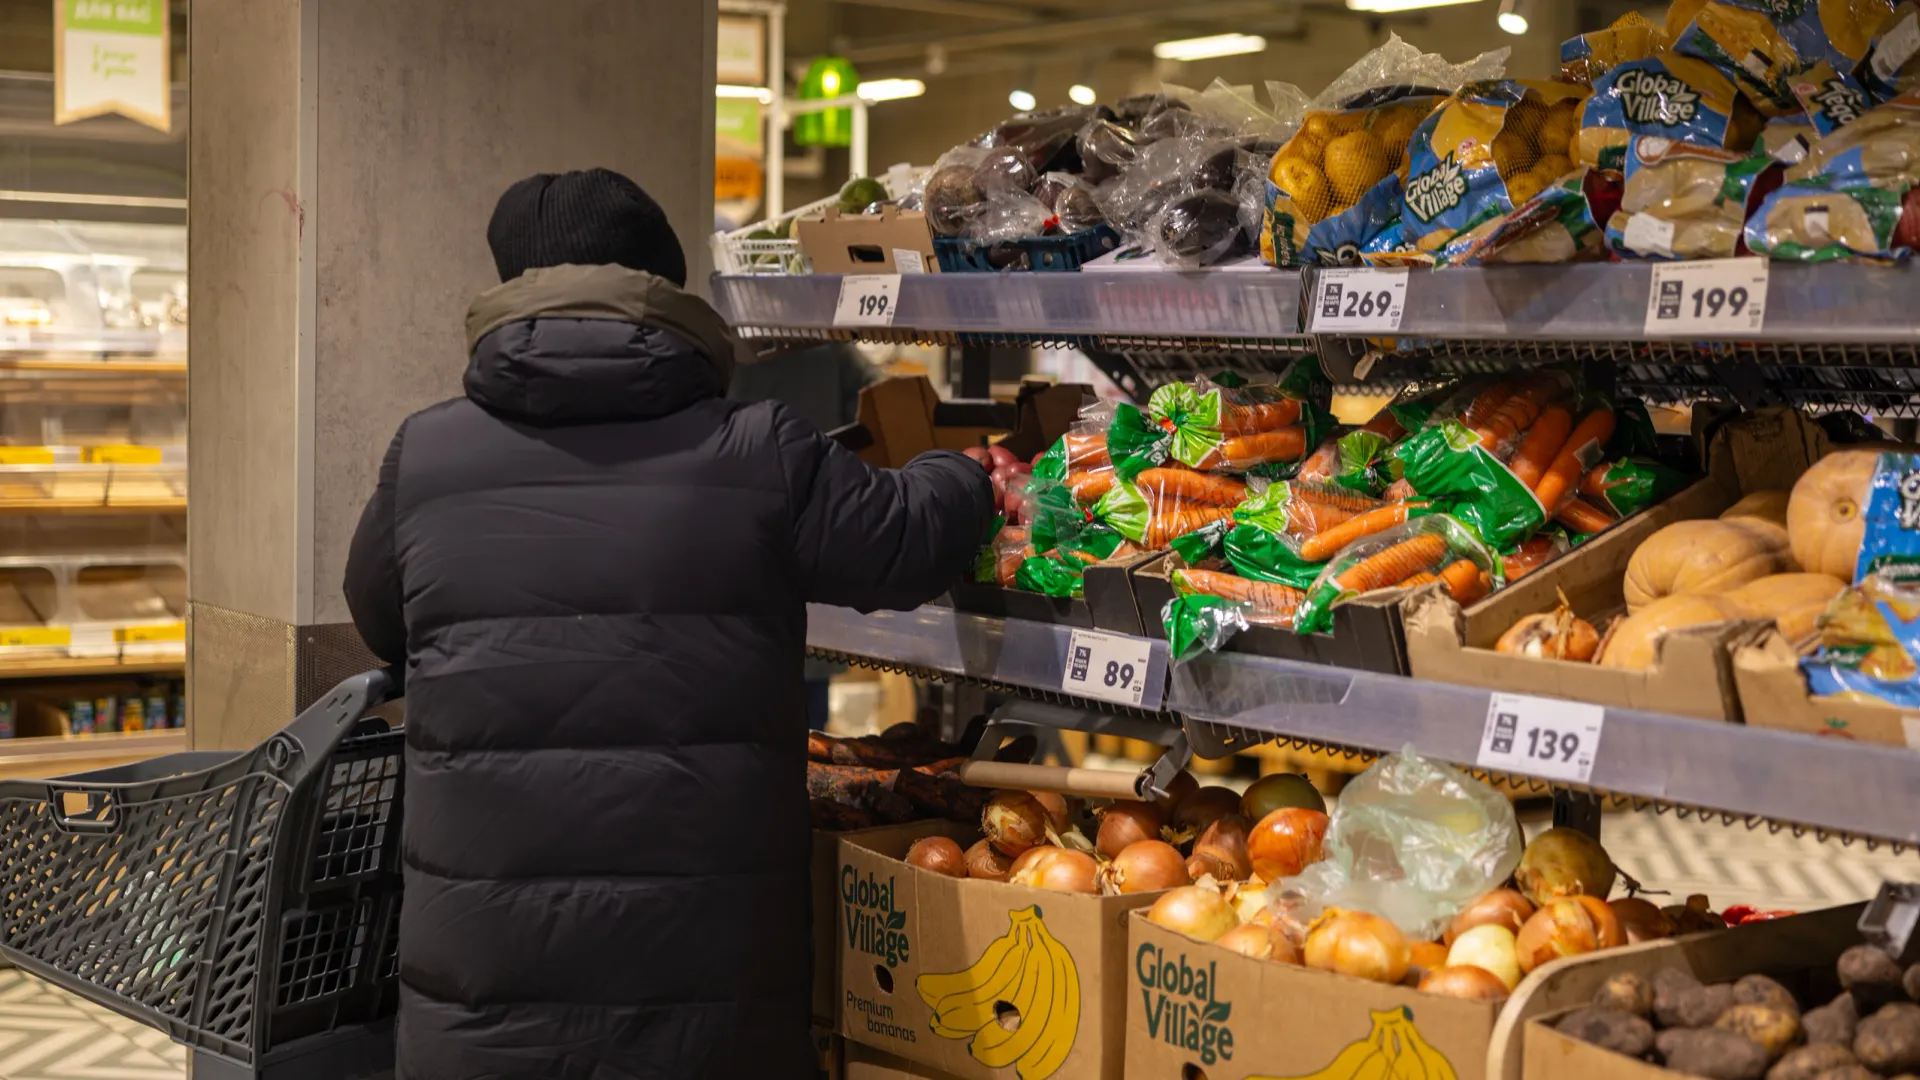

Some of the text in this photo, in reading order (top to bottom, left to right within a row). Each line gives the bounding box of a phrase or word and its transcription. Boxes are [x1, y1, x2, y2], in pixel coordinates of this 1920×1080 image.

[1616, 71, 1686, 96] Global
[1622, 93, 1694, 125] Village
[1406, 155, 1454, 203] Global
[1410, 177, 1465, 222] Village
[859, 294, 889, 316] 199
[1343, 290, 1392, 317] 269
[1692, 286, 1749, 318] 199
[1103, 660, 1135, 690] 89
[1527, 726, 1580, 763] 139
[841, 864, 897, 912] Global
[844, 905, 910, 968] Village
[1136, 942, 1217, 1002] Global
[846, 989, 894, 1020] Premium
[867, 1016, 917, 1043] bananas
[1141, 988, 1234, 1065] Village
